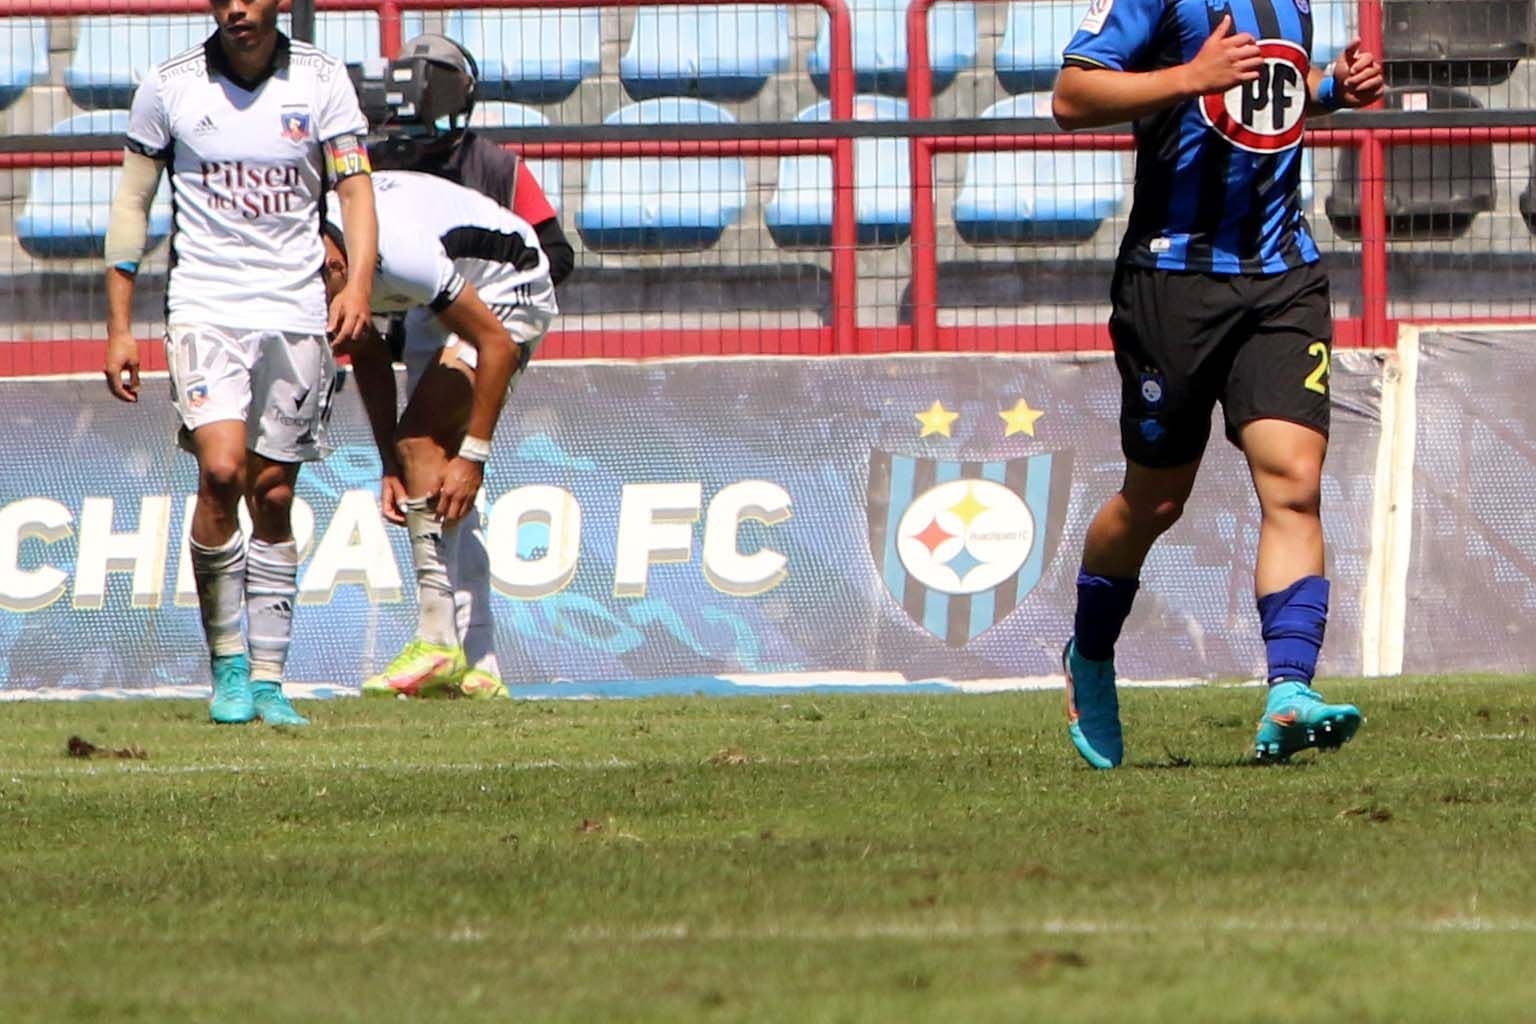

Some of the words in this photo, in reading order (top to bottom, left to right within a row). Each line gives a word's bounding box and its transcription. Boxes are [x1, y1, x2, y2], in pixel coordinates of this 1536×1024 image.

[1241, 62, 1298, 130] PF
[201, 160, 299, 188] Pilsen
[343, 154, 359, 175] 17
[242, 190, 297, 220] Sur
[180, 331, 224, 373] 17
[613, 478, 793, 598] FC
